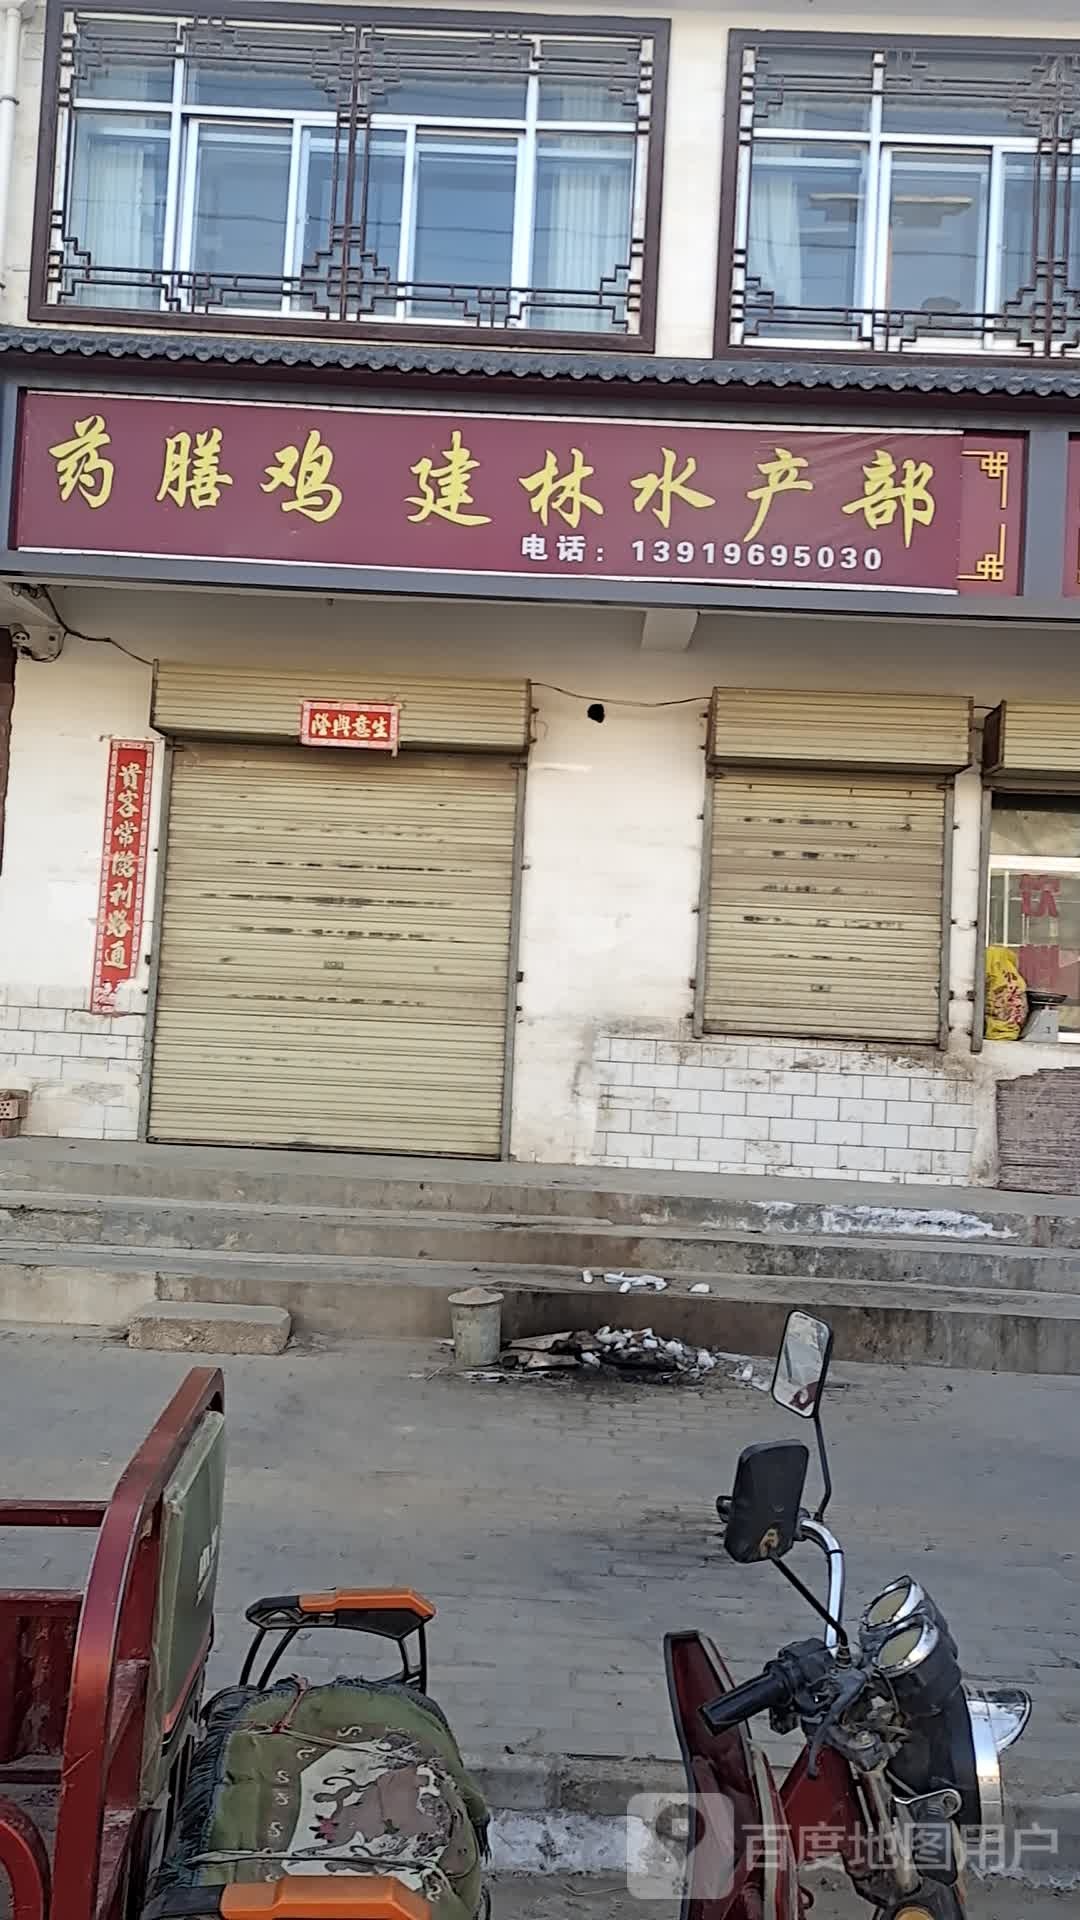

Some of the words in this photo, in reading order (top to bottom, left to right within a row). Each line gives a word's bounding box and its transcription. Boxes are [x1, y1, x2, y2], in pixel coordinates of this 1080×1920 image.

[48, 414, 343, 523] 药膳鸡
[403, 429, 937, 549] 建林水产部
[630, 540, 883, 571] 13919695030
